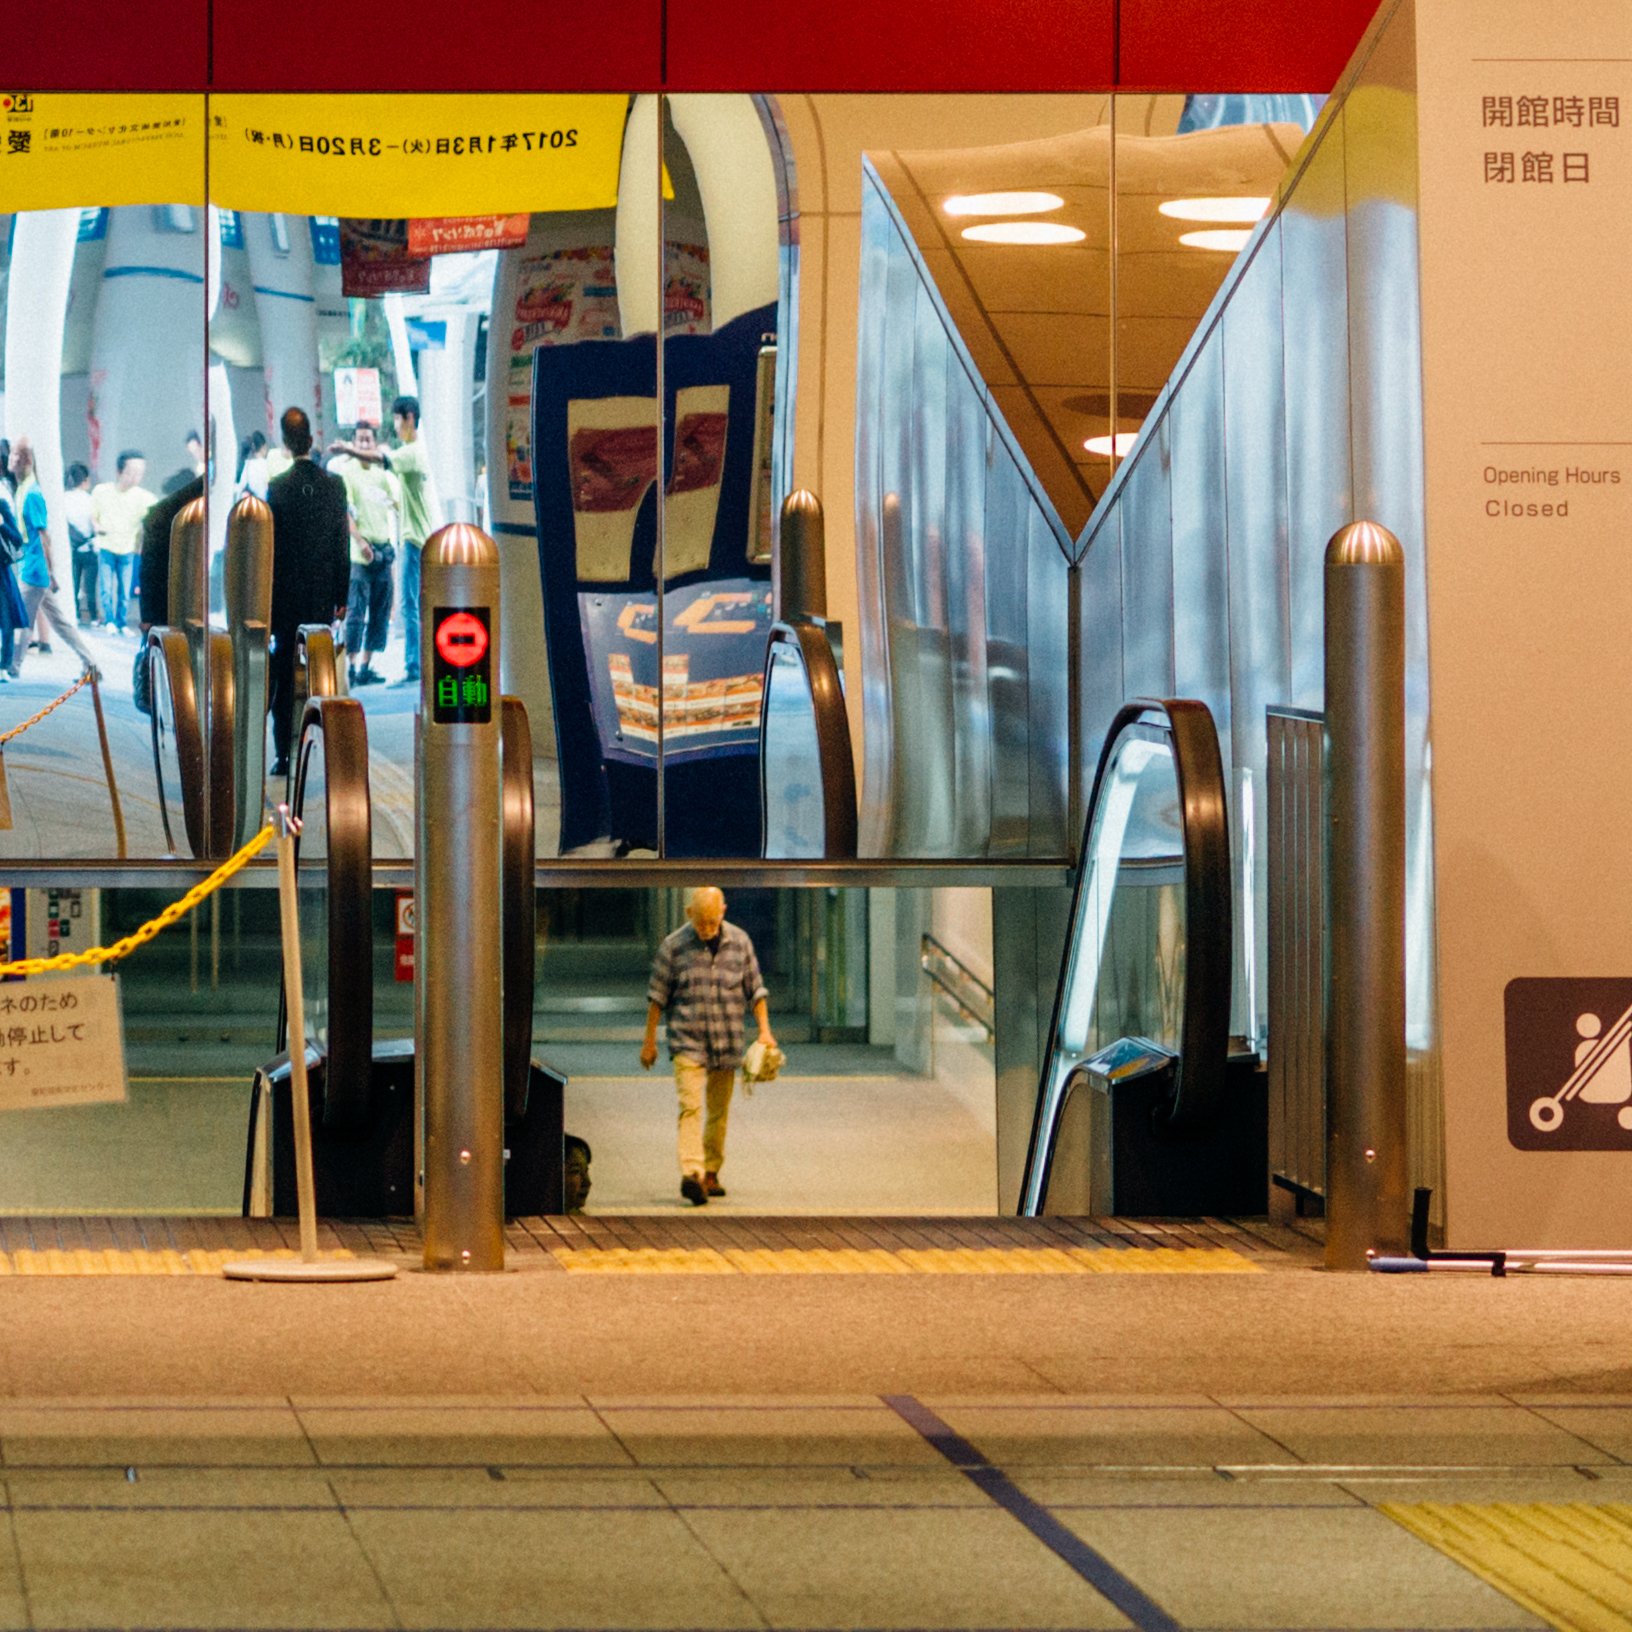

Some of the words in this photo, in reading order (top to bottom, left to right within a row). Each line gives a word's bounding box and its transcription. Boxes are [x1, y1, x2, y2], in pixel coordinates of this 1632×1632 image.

[1481, 95, 1621, 129] 開館時間
[1483, 150, 1592, 185] 閉館日
[1482, 465, 1560, 487] Opening
[1565, 465, 1622, 485] Hours
[1484, 498, 1570, 518] Closed
[437, 674, 488, 708] 自動
